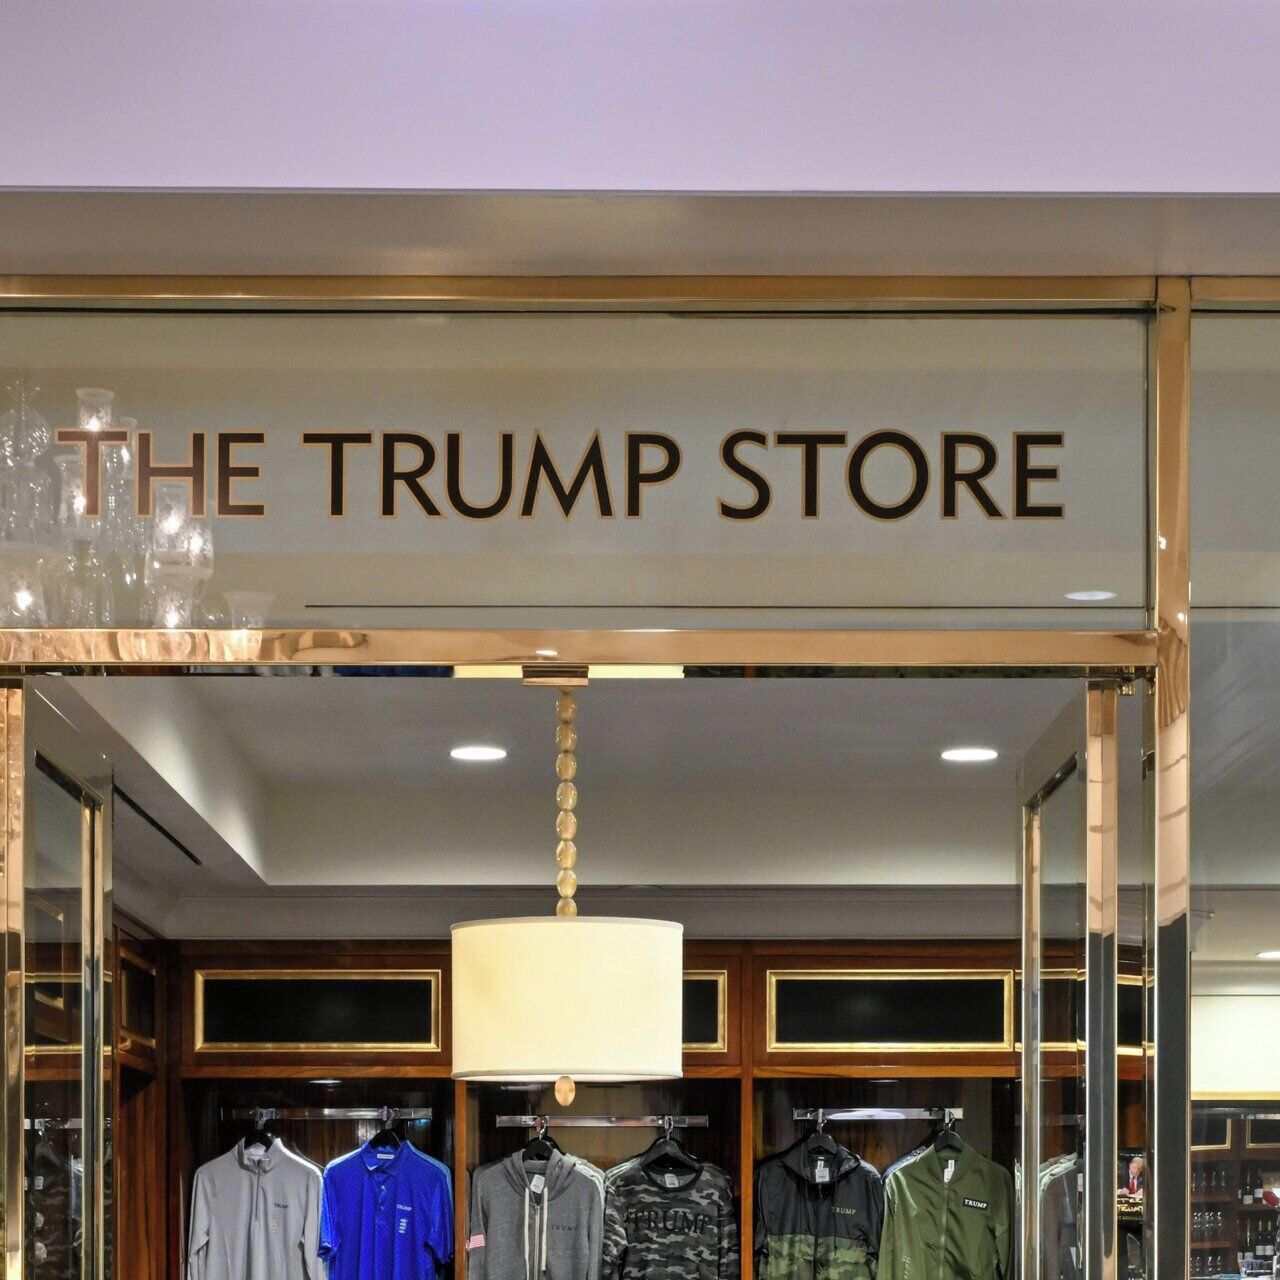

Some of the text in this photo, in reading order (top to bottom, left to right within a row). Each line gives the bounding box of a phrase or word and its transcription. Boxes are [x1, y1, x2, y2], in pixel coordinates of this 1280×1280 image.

[56, 428, 1066, 521] THE TRUMP STORE
[965, 1199, 988, 1209] TRUMP
[831, 1206, 857, 1216] TRUMP
